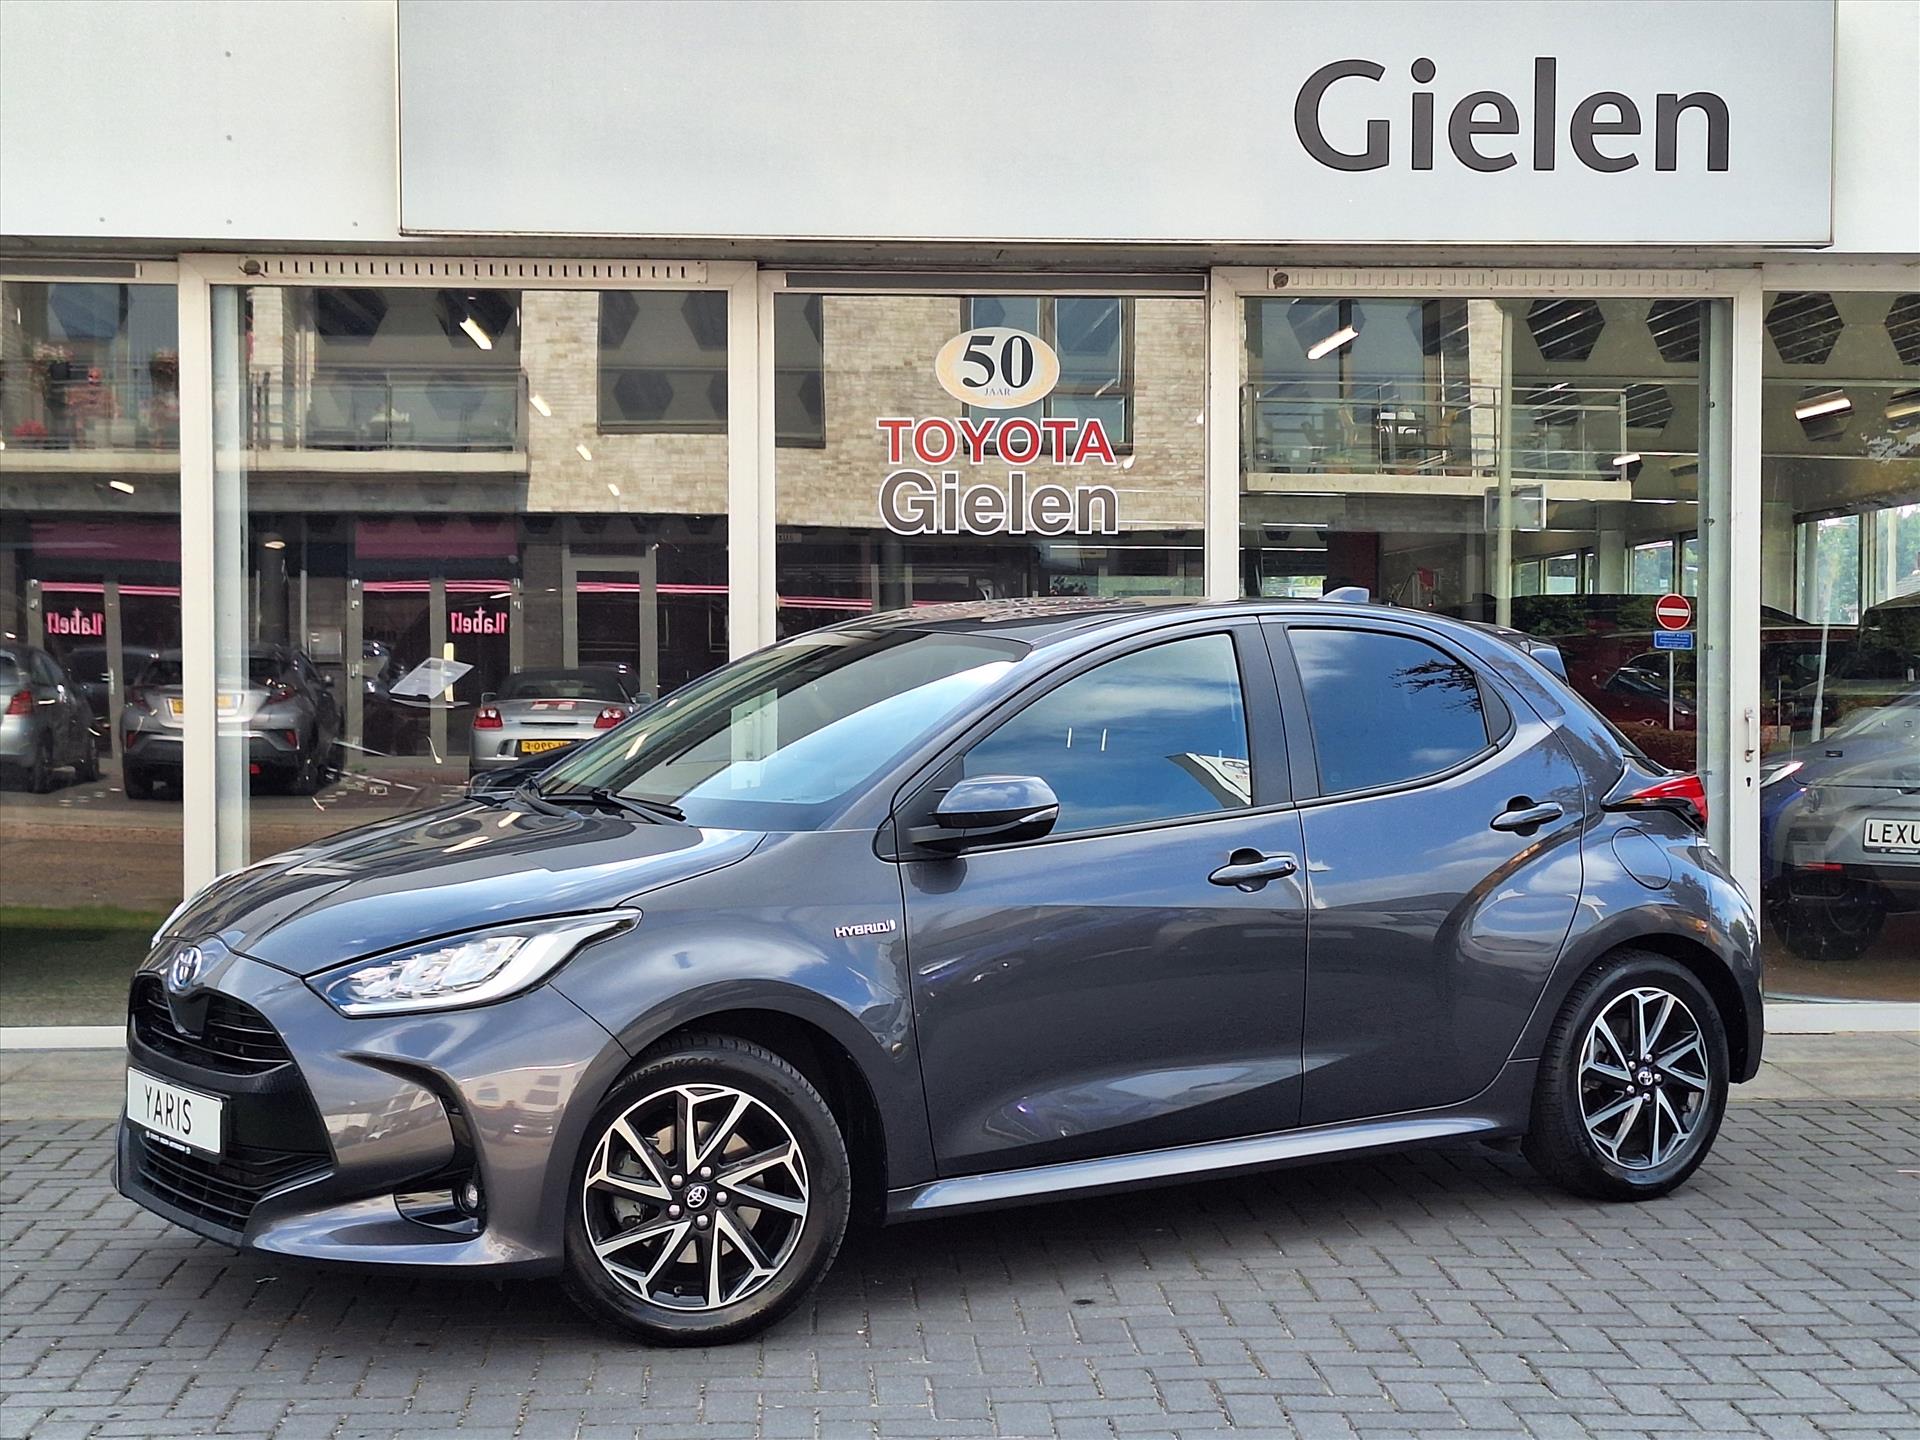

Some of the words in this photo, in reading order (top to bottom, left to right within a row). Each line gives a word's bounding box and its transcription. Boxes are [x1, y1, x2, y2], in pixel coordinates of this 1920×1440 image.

[1294, 56, 1730, 173] Gielen
[962, 335, 1034, 388] 50
[984, 387, 1011, 397] JAAR
[877, 417, 1117, 466] TOYOTA
[879, 469, 1119, 535] Gielen
[834, 920, 890, 938] HYBRID
[145, 1084, 192, 1135] YARIS
